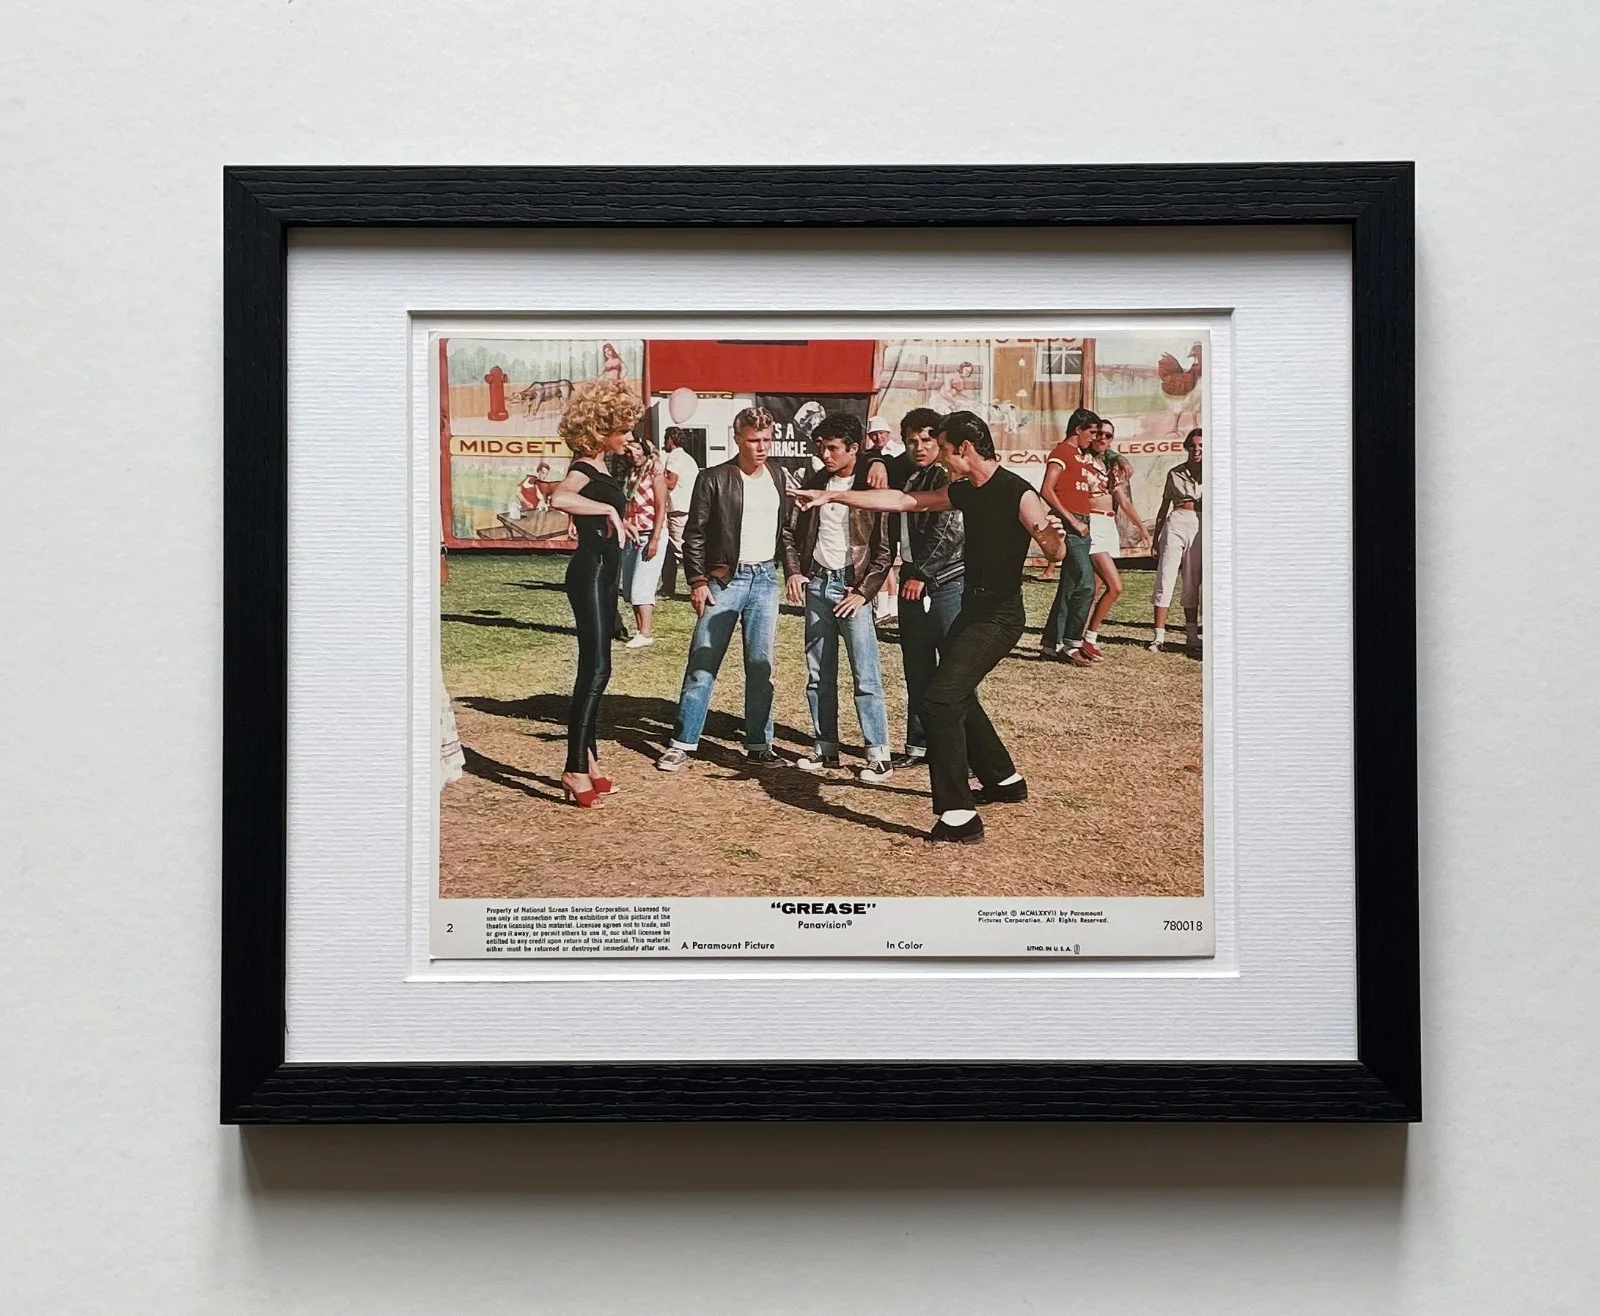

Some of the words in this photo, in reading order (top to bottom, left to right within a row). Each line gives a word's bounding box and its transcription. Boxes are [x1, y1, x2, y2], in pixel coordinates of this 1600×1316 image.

[786, 423, 795, 439] A
[460, 440, 562, 454] MIDGET
[1117, 441, 1183, 454] LEGGE
[771, 902, 876, 914] “GREASE”
[446, 924, 453, 933] 2
[1163, 921, 1203, 931] 780018
[681, 941, 689, 950] A
[692, 941, 741, 950] Paramount
[745, 941, 775, 950] Picture
[886, 941, 896, 949] In
[898, 941, 924, 950] Color
